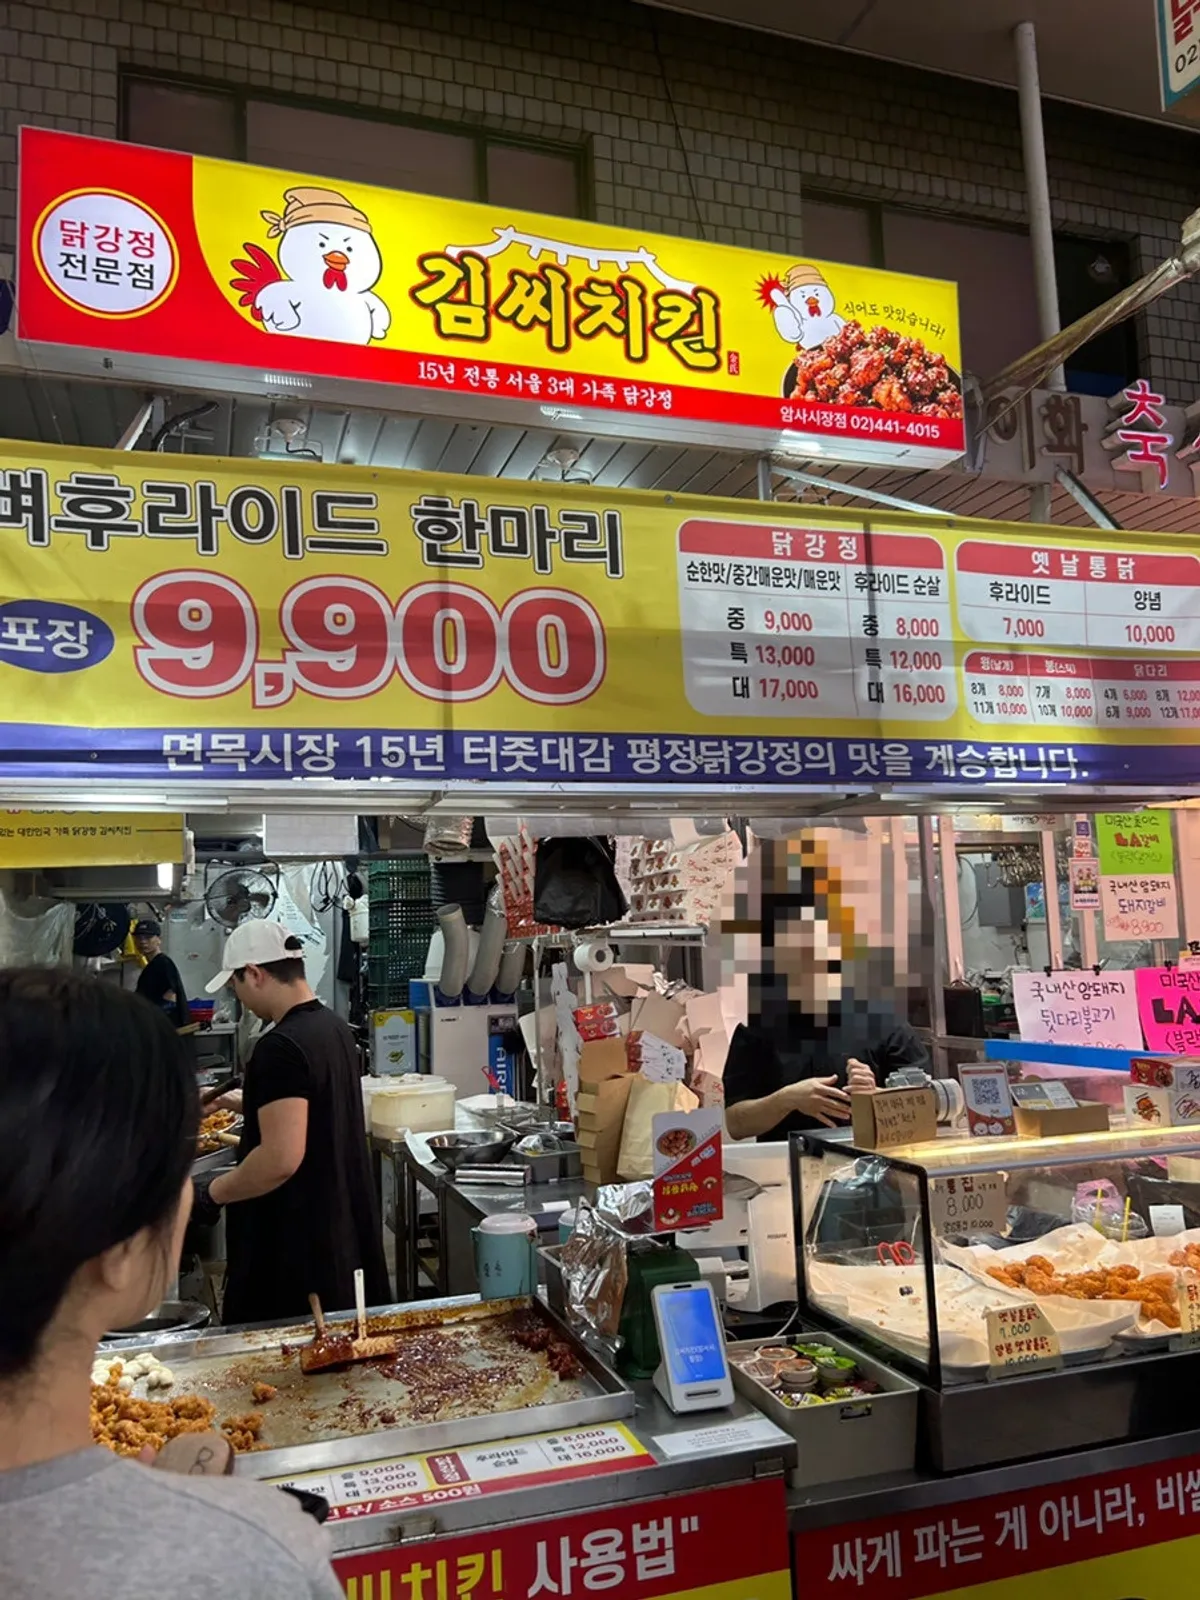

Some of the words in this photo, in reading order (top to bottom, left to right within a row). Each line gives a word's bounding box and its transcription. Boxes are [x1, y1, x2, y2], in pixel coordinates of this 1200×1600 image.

[58, 217, 156, 259] 닭강정
[57, 252, 156, 292] 전문점
[409, 251, 723, 374] 김씨치킨
[843, 301, 881, 317] 식어도
[883, 305, 946, 340] 맛있습니다!
[418, 361, 455, 384] 15년
[464, 365, 500, 390] 전통
[506, 371, 541, 395] 서울
[547, 376, 575, 399] 3대
[582, 381, 616, 405] 가족
[623, 386, 673, 410] 닭강정
[780, 406, 847, 429] 암사시장점
[850, 417, 941, 439] 02)441-4015
[987, 391, 1089, 476] 이화
[410, 493, 625, 578] 한마리
[854, 571, 910, 595] 후라이드
[913, 574, 941, 597] 순살
[989, 581, 1051, 605] 후라이드
[1134, 590, 1162, 612] 양념
[0, 616, 94, 661] 포장
[131, 568, 607, 709] 9,900
[726, 607, 745, 631] 중
[764, 610, 813, 633] 9,000
[862, 614, 879, 637] 중
[896, 617, 940, 638] 8,000
[1003, 617, 1044, 639] 7,000
[1125, 624, 1175, 645] 10,000
[730, 642, 748, 664] 특
[755, 644, 815, 668] 13,000
[865, 648, 882, 670] 특
[889, 650, 942, 672] 12,000
[1134, 664, 1168, 678] 닭다리
[732, 676, 750, 700] 대
[759, 678, 819, 702] 17,000
[867, 681, 885, 704] 대
[893, 684, 946, 707] 16,000
[971, 682, 986, 696] 8개
[998, 684, 1024, 698] 8,000
[1036, 685, 1050, 699] 7개
[1065, 687, 1092, 701] 8,000
[1104, 688, 1117, 701] 4개
[1155, 689, 1170, 703] 8개
[1177, 689, 1200, 703] 12,00
[974, 701, 994, 715] 11개
[996, 702, 1027, 717] 10,000
[1038, 704, 1057, 718] 10개
[1061, 705, 1093, 719] 10,000
[1106, 705, 1120, 719] 6개
[1126, 706, 1151, 720] 9,000
[1160, 706, 1179, 720] 12개
[162, 733, 340, 774] 면목시장
[357, 733, 445, 772] 15년
[463, 733, 615, 775] 터줏대감
[627, 737, 837, 777] 평정닭강정의
[848, 743, 913, 777] 맛을
[925, 744, 1089, 780] 계승합니다.
[1030, 981, 1075, 1002] 국내산
[345, 1488, 360, 1498] 대
[365, 1480, 418, 1495] 17,000
[575, 1445, 626, 1459] 16,000
[359, 1463, 406, 1477] 9,000
[563, 1430, 606, 1443] 8,000
[363, 1471, 417, 1486] 13,000
[569, 1437, 619, 1451] 12,000
[379, 1496, 418, 1511] 소스
[423, 1484, 482, 1501] 500원
[827, 1531, 902, 1586] 싸게
[914, 1518, 985, 1568] 파는
[995, 1504, 1028, 1551] 게
[1039, 1483, 1145, 1542] 아니라,
